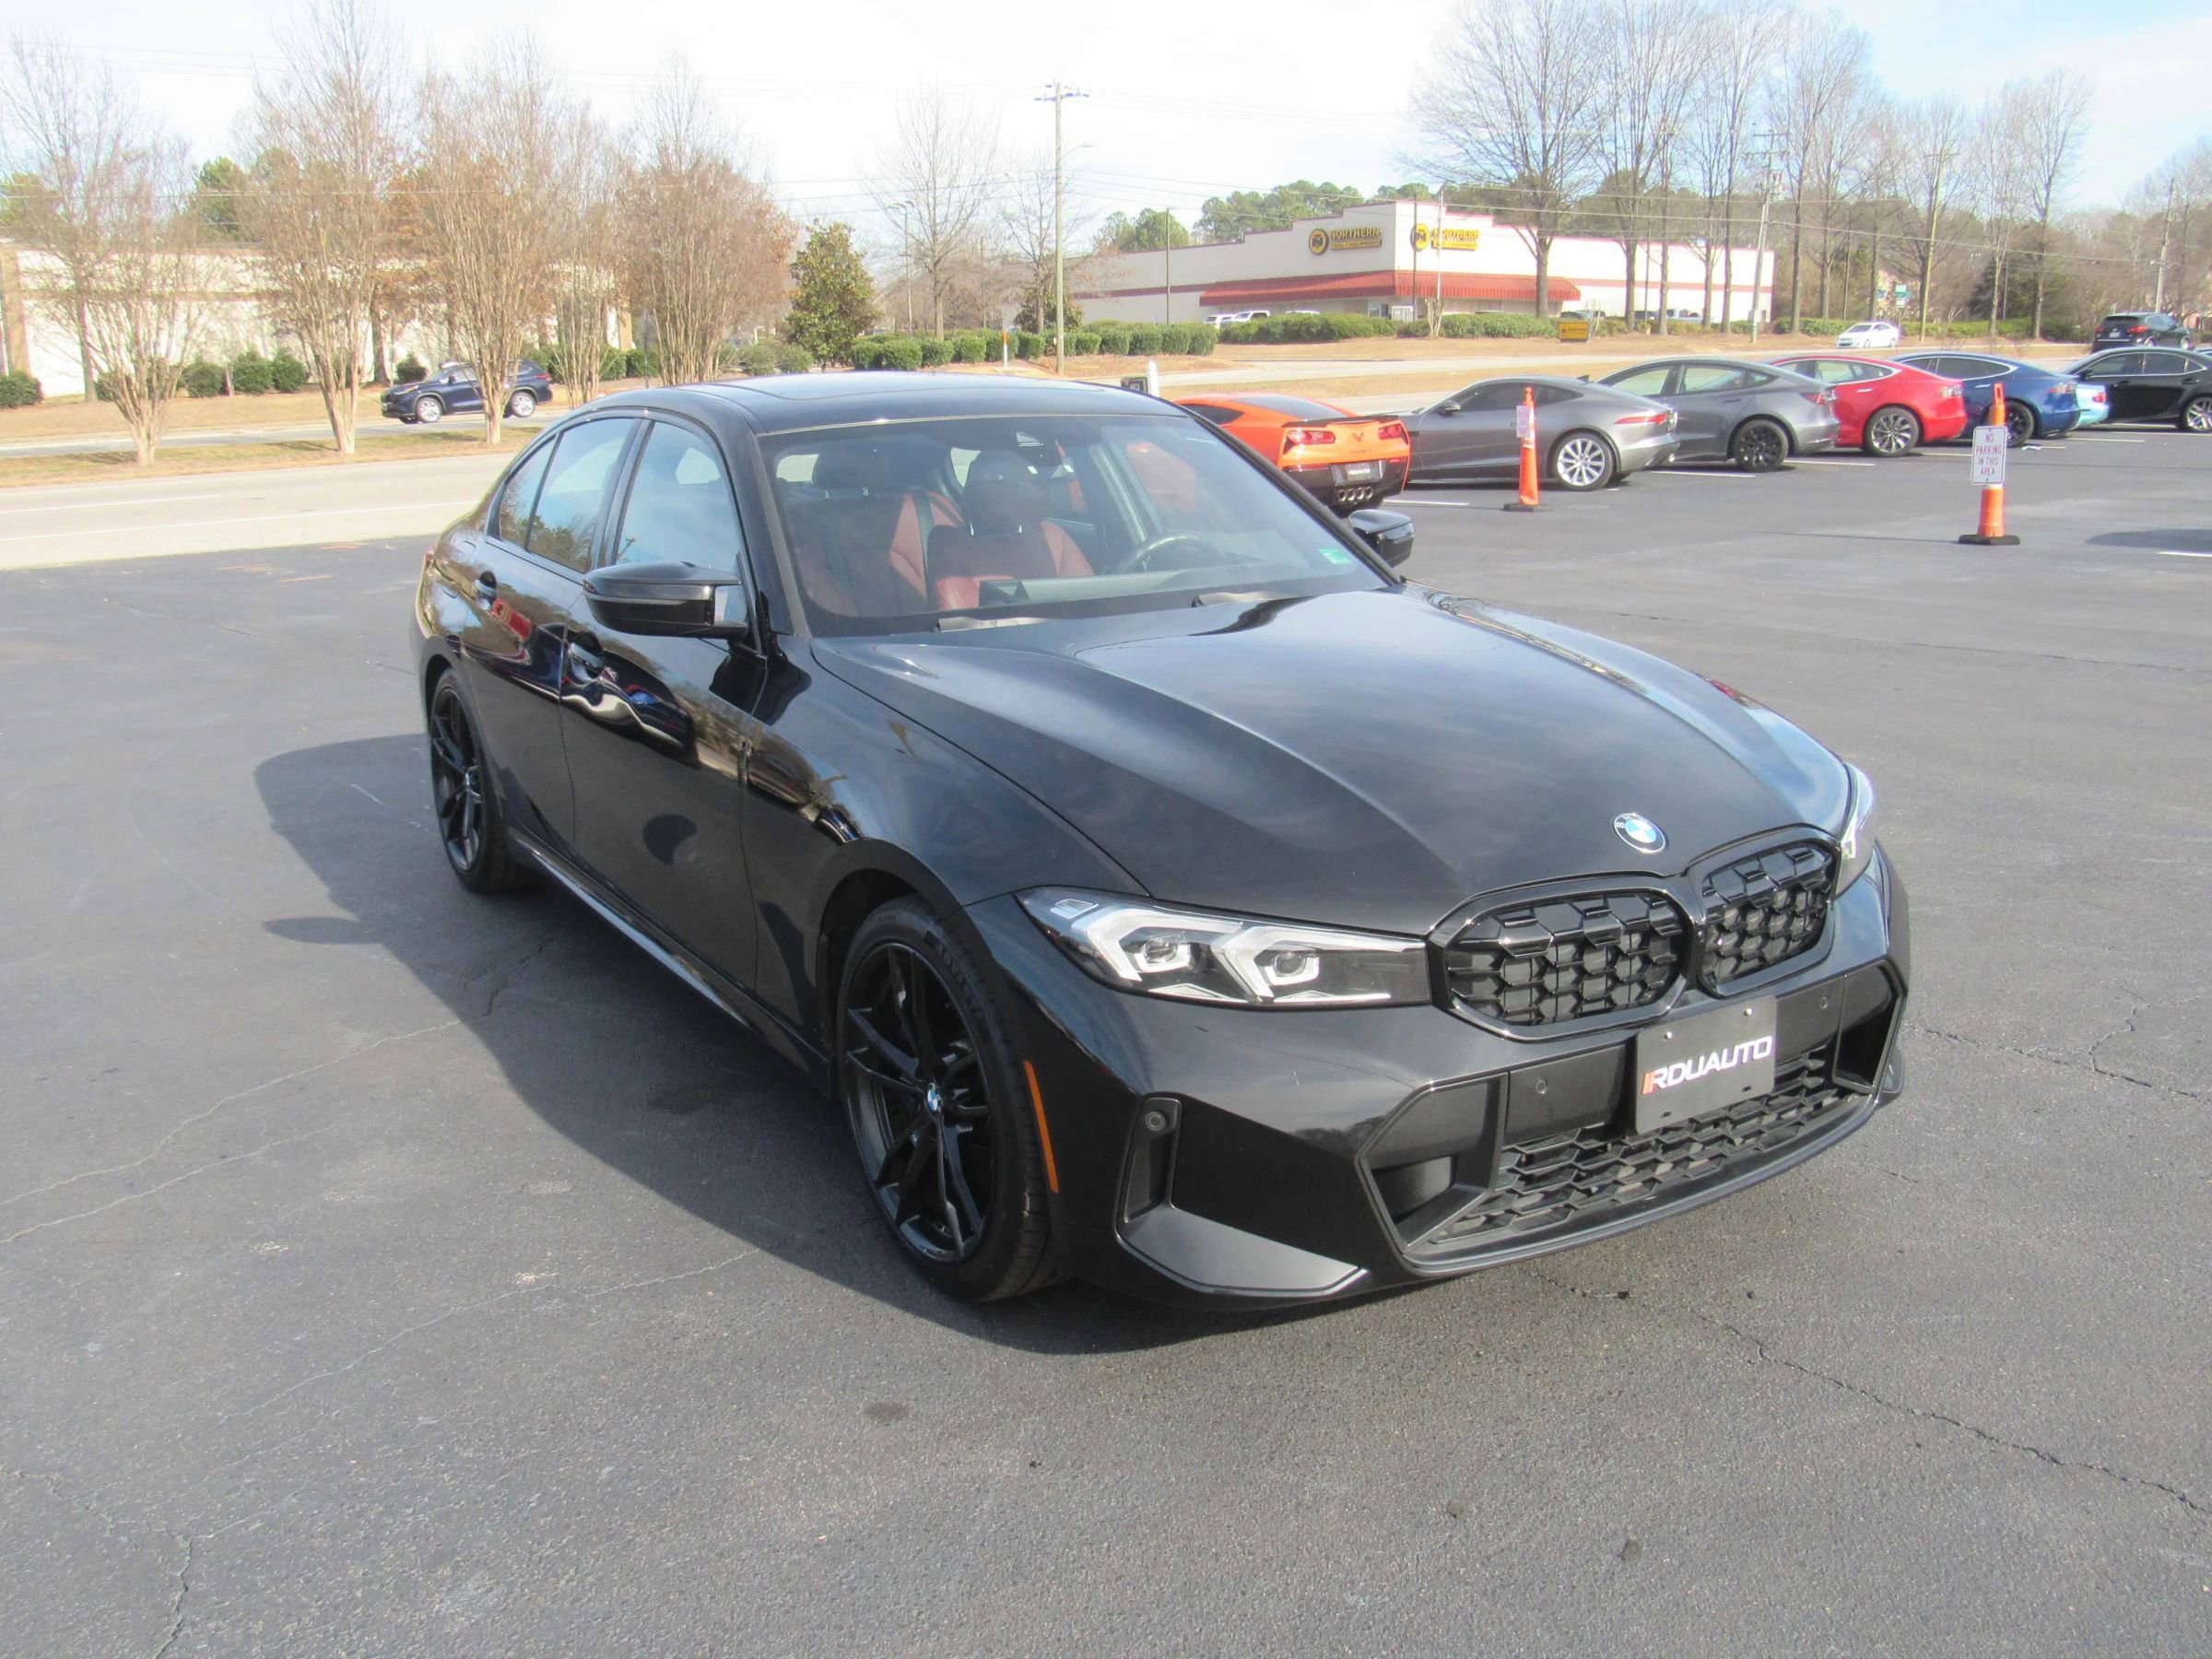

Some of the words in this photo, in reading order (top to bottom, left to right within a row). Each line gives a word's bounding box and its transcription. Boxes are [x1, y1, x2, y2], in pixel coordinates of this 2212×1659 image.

[1328, 228, 1381, 240] NORTHERN
[1985, 433, 1994, 442] NO
[1976, 445, 2003, 454] PARKING
[1986, 457, 1999, 465] THIS
[1980, 466, 1995, 476] AREA
[1642, 1035, 1773, 1094] RDUAUTO
